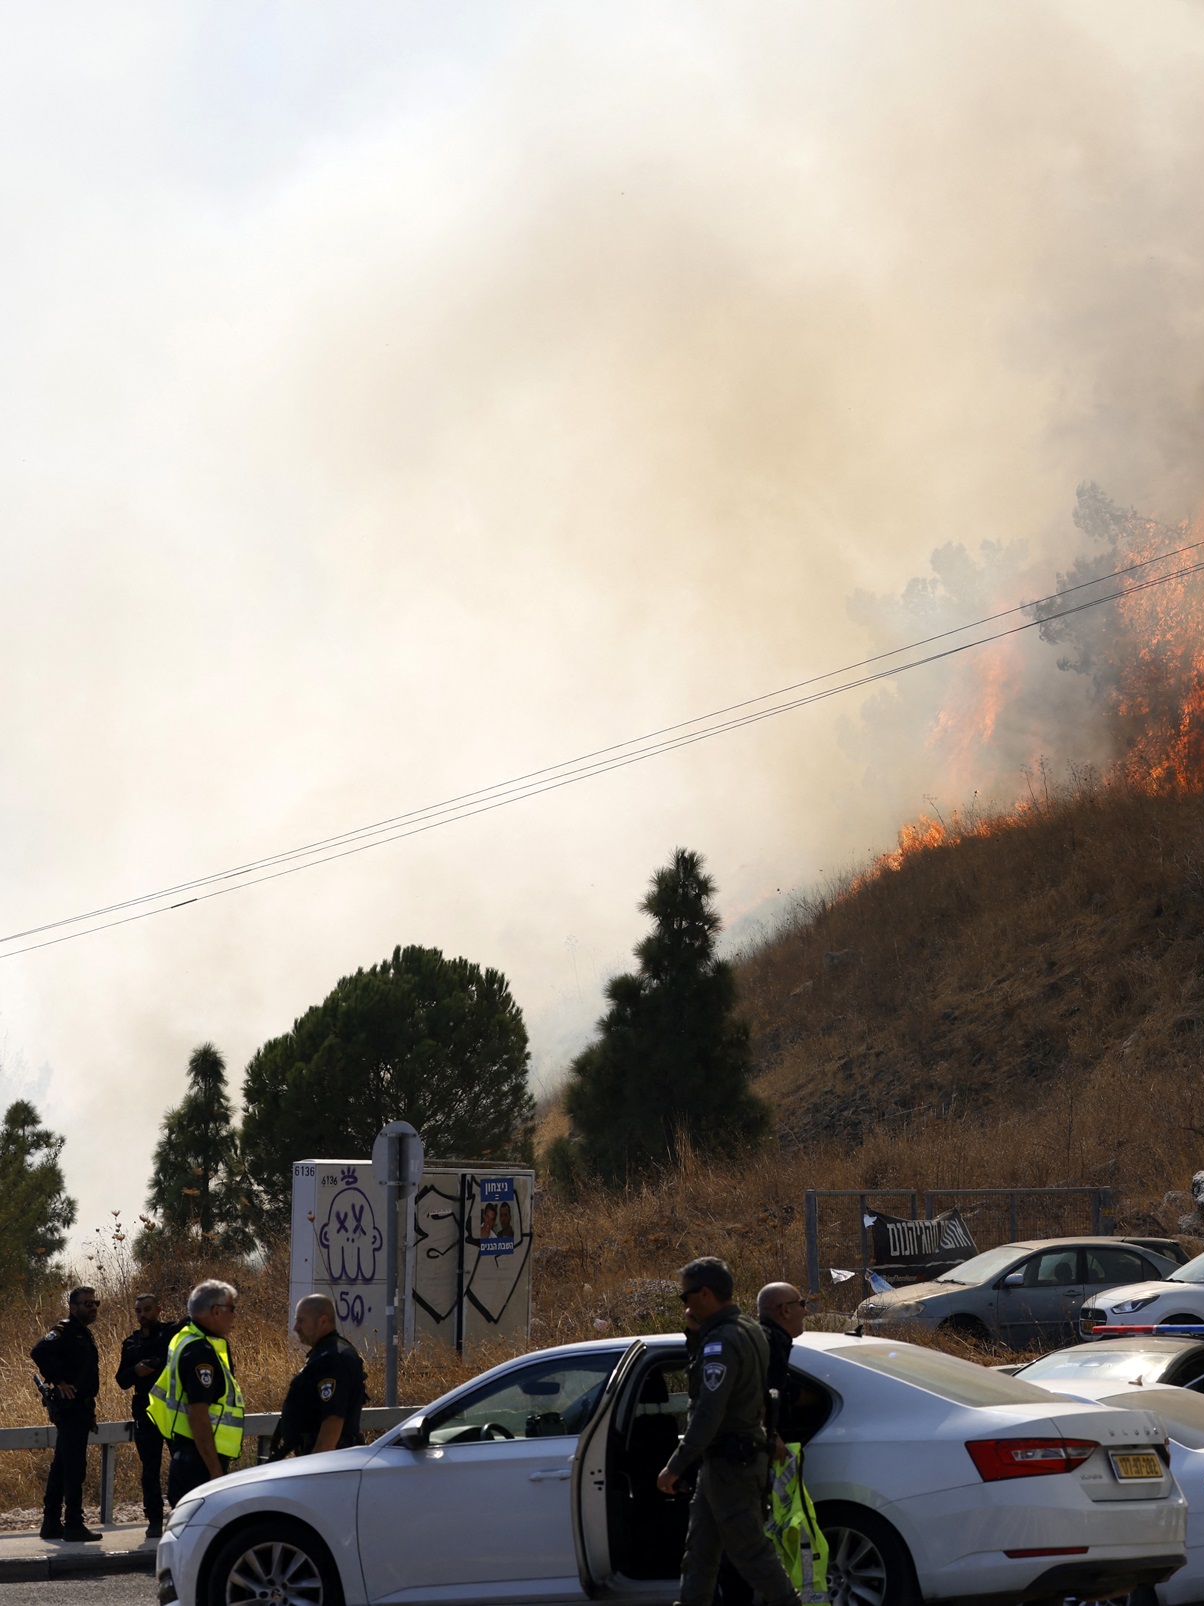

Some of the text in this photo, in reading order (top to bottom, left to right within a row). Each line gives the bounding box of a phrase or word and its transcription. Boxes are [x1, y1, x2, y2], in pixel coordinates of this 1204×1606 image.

[294, 1166, 315, 1177] 6136
[321, 1175, 338, 1186] 6136
[485, 1182, 508, 1195] ניצחון
[480, 1242, 514, 1251] השבת הבנים
